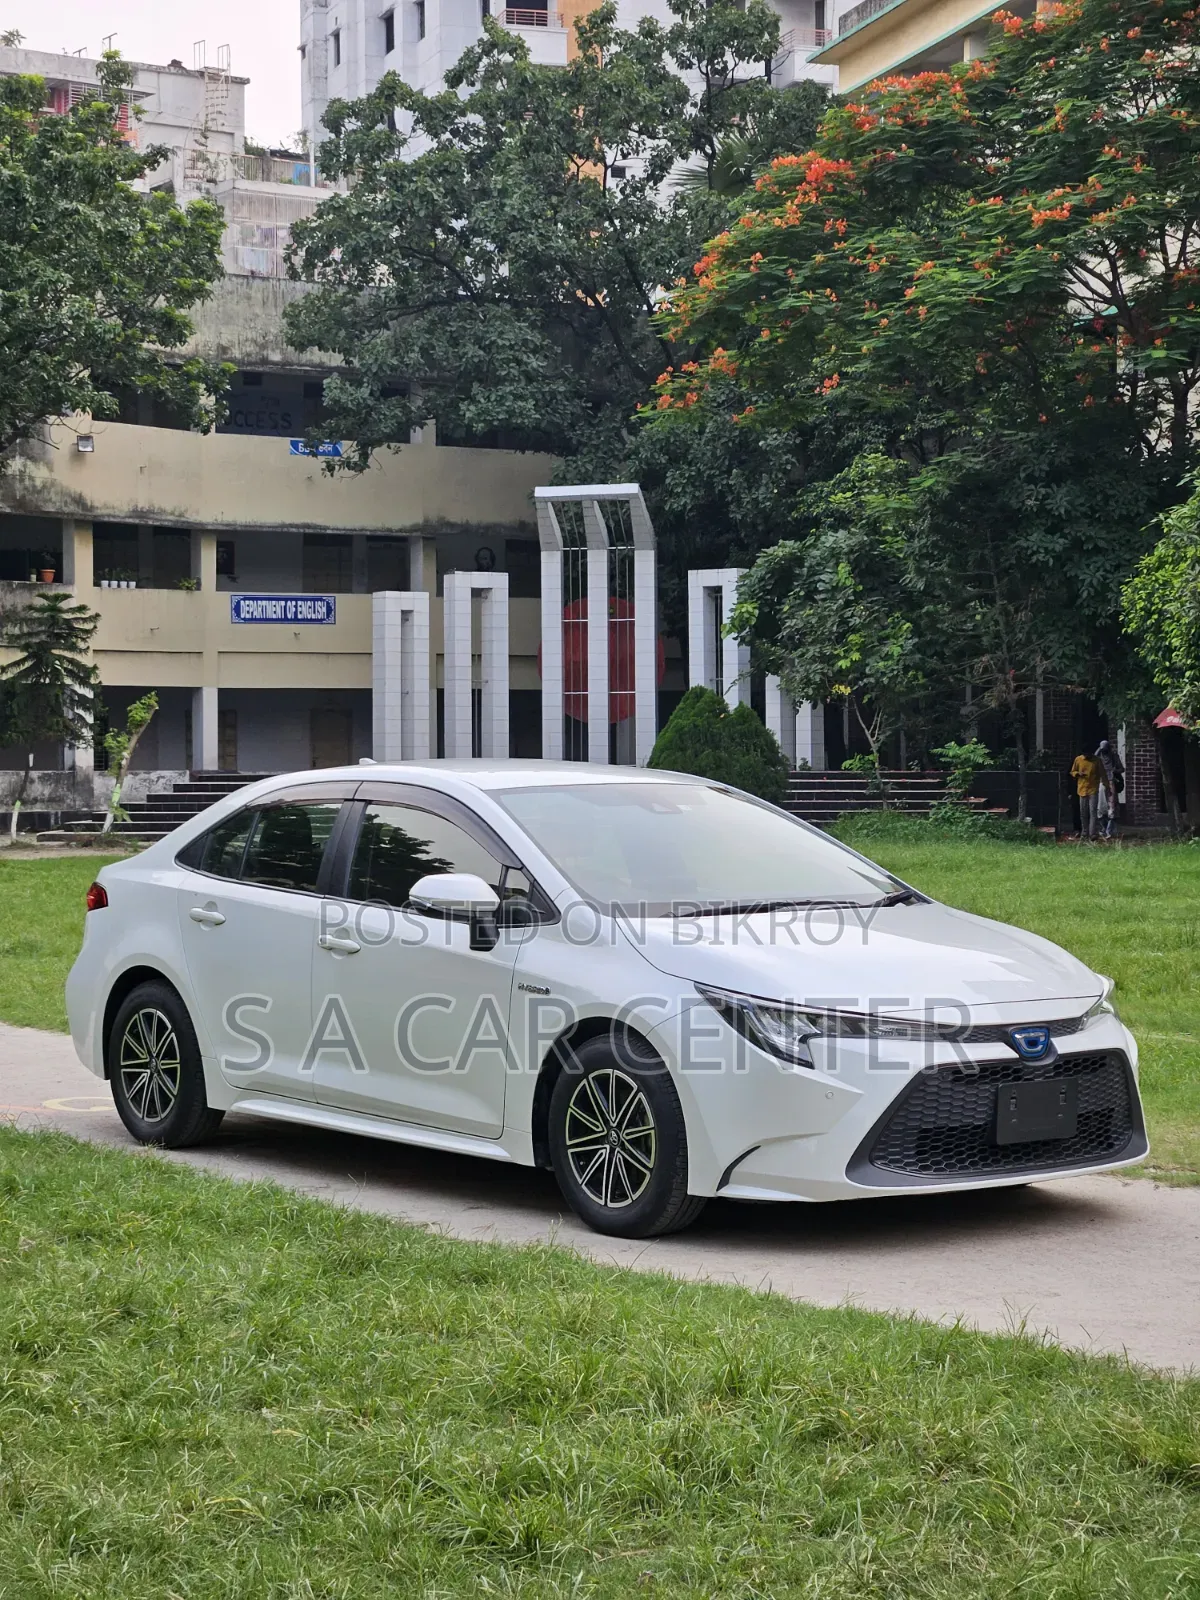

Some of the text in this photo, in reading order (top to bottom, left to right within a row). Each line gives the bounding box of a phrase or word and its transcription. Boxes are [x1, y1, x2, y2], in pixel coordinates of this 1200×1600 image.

[222, 409, 293, 430] UCCESS
[240, 600, 327, 620] DEPARTMENT OF ENGLISH
